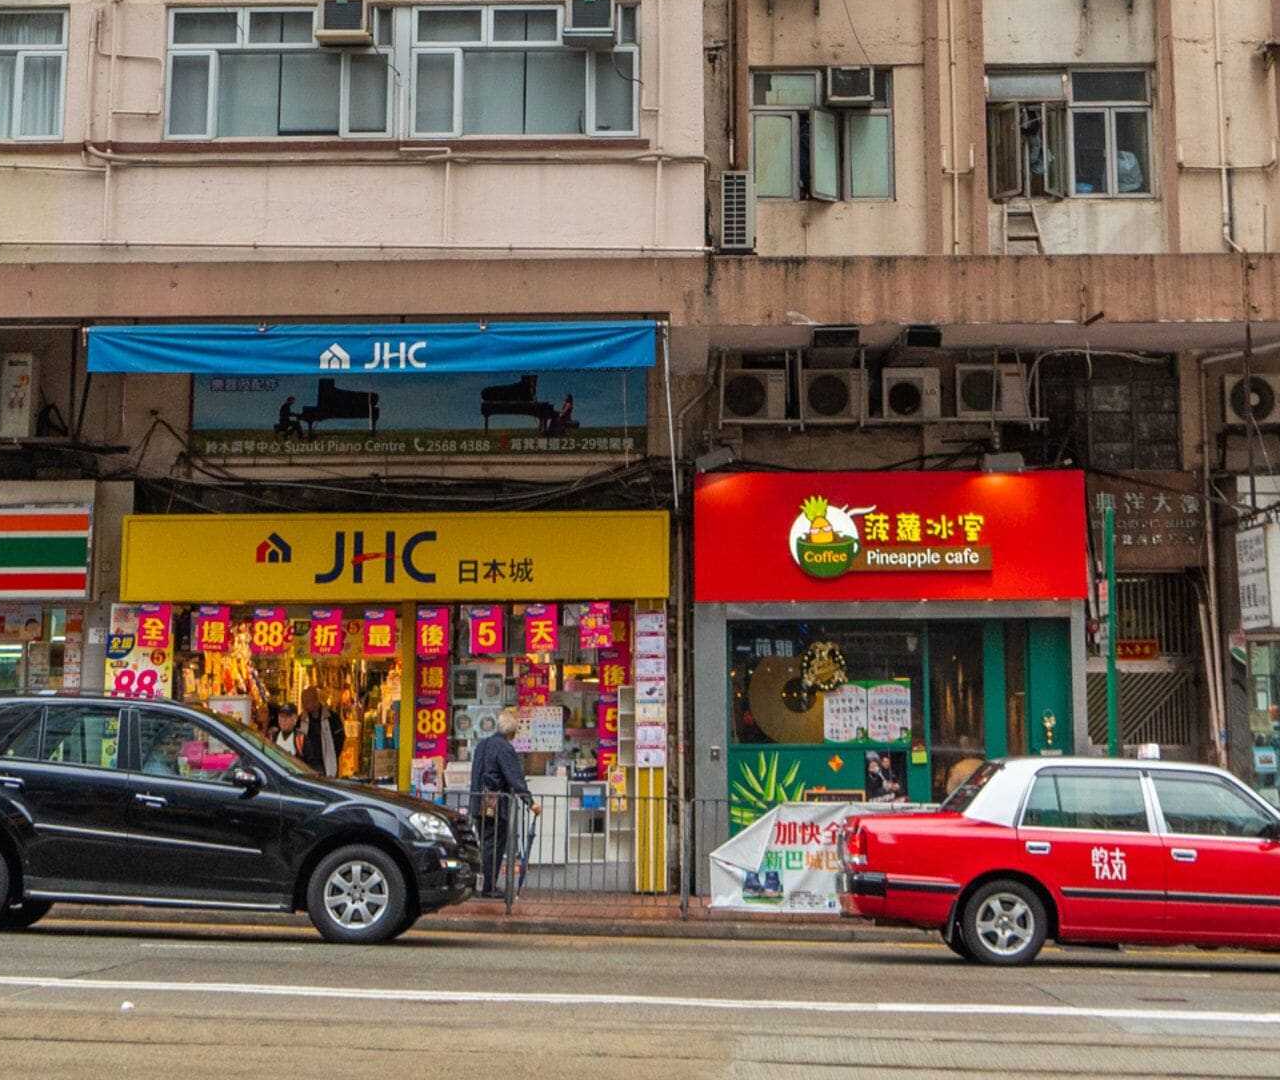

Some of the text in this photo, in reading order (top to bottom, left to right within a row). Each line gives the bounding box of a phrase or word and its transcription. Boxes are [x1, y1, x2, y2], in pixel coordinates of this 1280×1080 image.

[364, 341, 427, 369] JHC
[284, 439, 323, 453] Suzuki
[327, 439, 361, 453] Piano
[365, 439, 406, 452] Centre
[426, 439, 456, 452] 2568
[459, 439, 490, 452] 4388
[863, 512, 984, 542] 菠蘿冰室
[314, 531, 437, 583] JHC
[803, 549, 848, 564] Coffee
[866, 548, 980, 569] Pineapple cafe
[458, 558, 534, 584] 日本城
[142, 618, 166, 641] 全
[202, 621, 225, 644] 場
[253, 621, 284, 647] 88
[314, 624, 338, 647] 折
[368, 624, 391, 647] 最
[421, 624, 444, 647] 後
[478, 621, 496, 647] 5
[530, 620, 554, 643] 天
[422, 666, 444, 689] 場
[603, 664, 625, 687] 後
[417, 708, 446, 734] 88
[1091, 846, 1126, 867] 的士
[1093, 862, 1127, 881] TAXI
